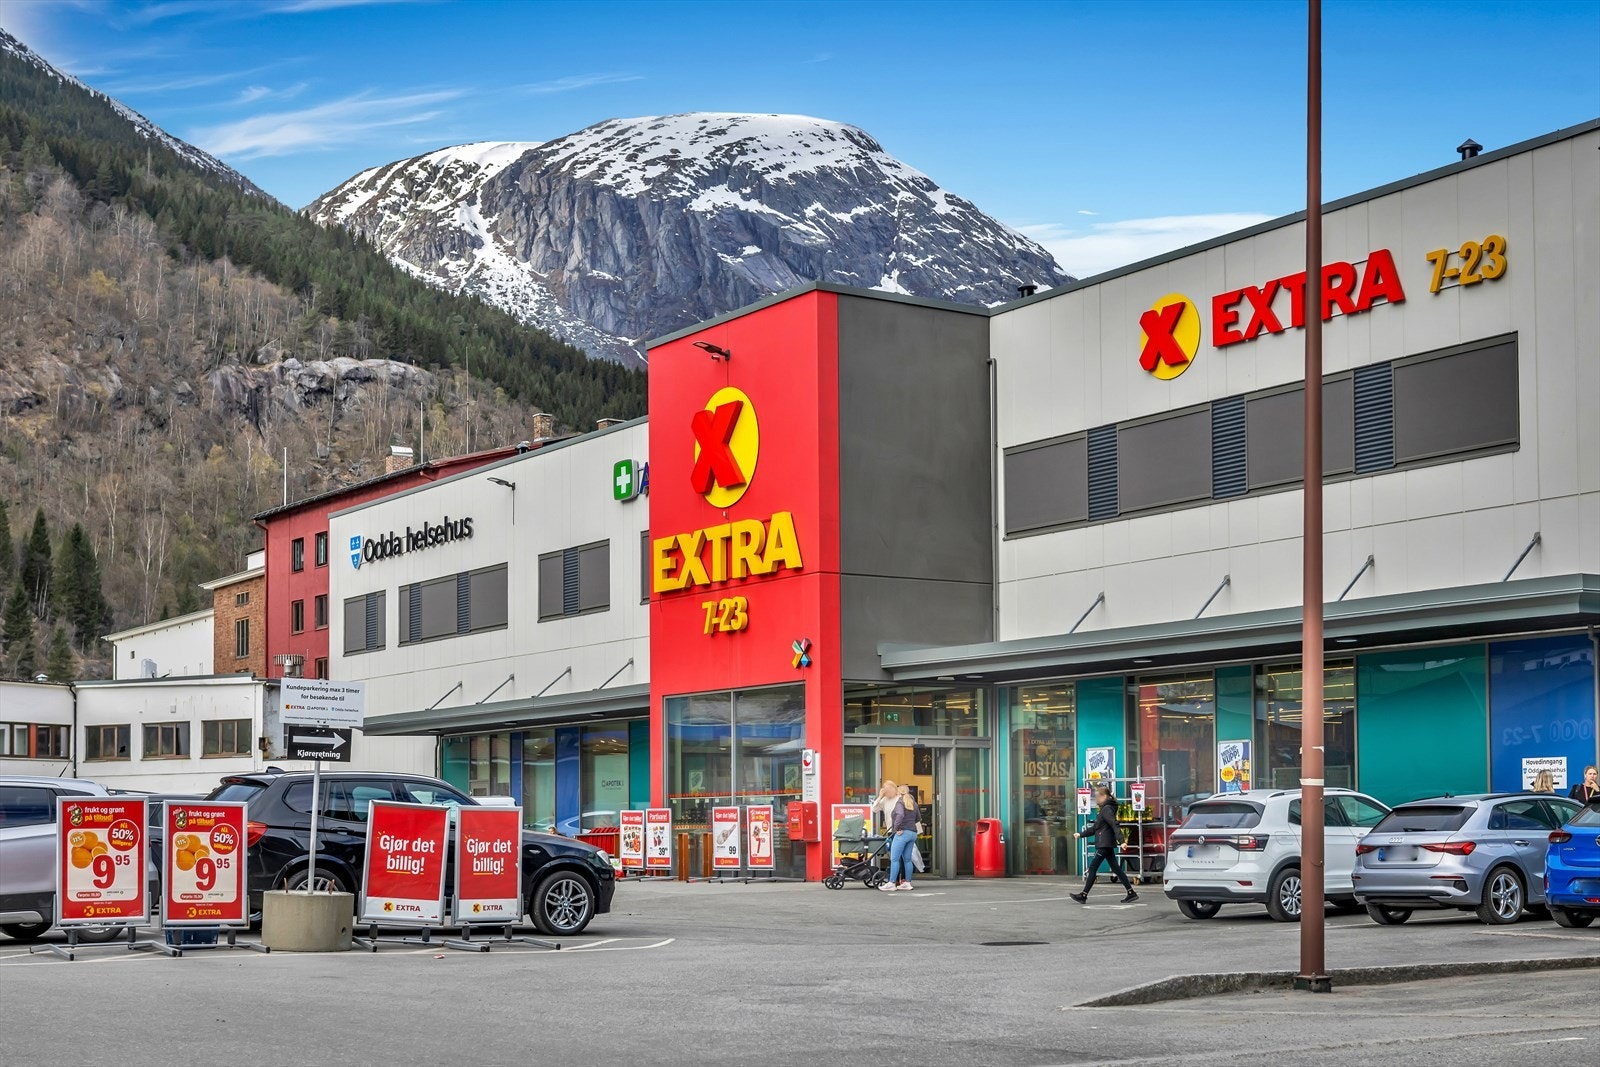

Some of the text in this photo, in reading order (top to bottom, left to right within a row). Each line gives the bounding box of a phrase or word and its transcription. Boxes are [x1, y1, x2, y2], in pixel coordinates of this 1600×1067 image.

[1212, 234, 1509, 347] EXTRA 7-23
[364, 516, 473, 562] Odda helsehus
[653, 511, 804, 594] EXTRA
[702, 596, 749, 634] 7-23
[286, 684, 328, 692] Kundeparkering
[298, 750, 340, 760] Kjøreretning
[1222, 749, 1240, 765] KUPP!
[112, 828, 134, 840] 50%
[214, 832, 234, 844] 50%
[380, 835, 435, 853] Gjør det
[467, 839, 512, 856] Gjør det
[659, 847, 666, 856] 39
[729, 846, 736, 854] 99
[93, 855, 130, 889] 9 95
[387, 855, 424, 874] billig!
[473, 858, 504, 874] billig!
[196, 858, 230, 891] 9 95
